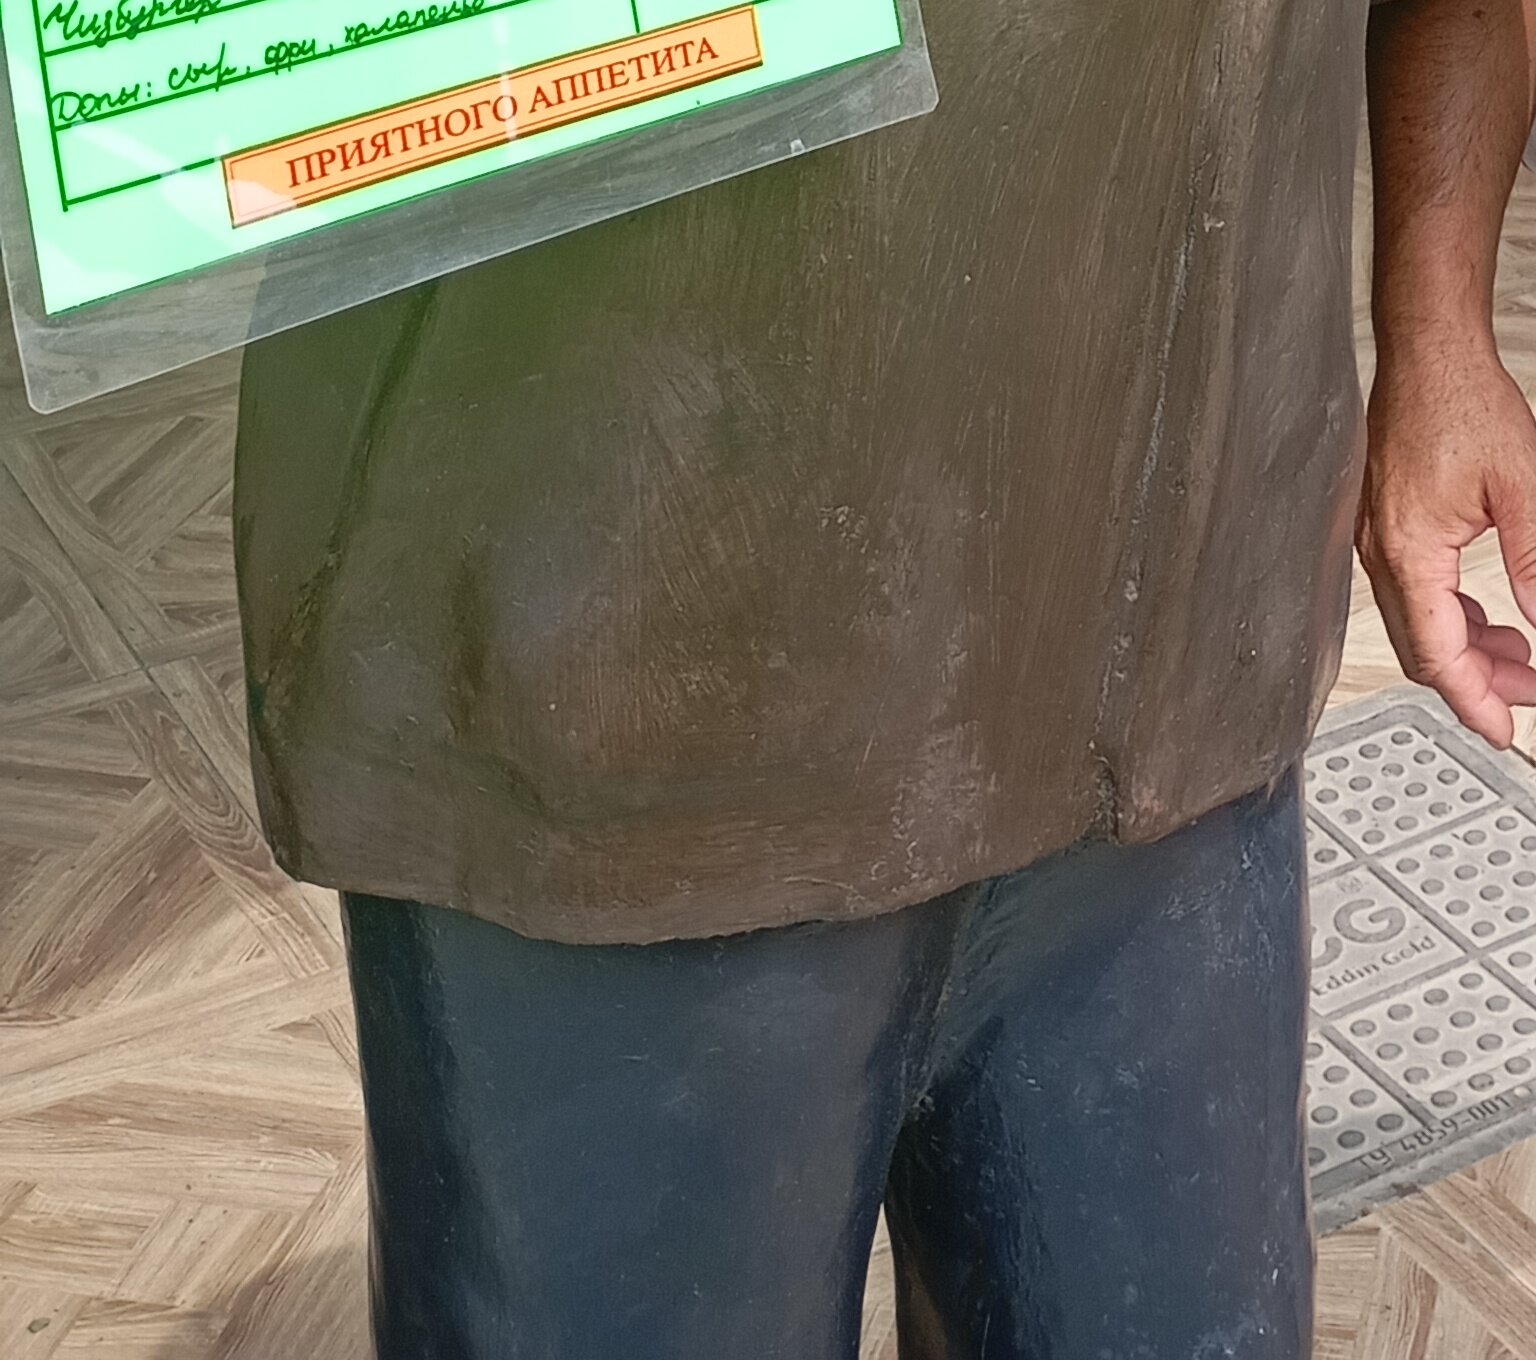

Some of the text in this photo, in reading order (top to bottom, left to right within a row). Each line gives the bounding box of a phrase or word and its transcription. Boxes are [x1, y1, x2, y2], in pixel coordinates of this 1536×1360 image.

[286, 36, 720, 189] ПРИЯТНОГО АППЕТИТА
[1380, 935, 1436, 966] Gold
